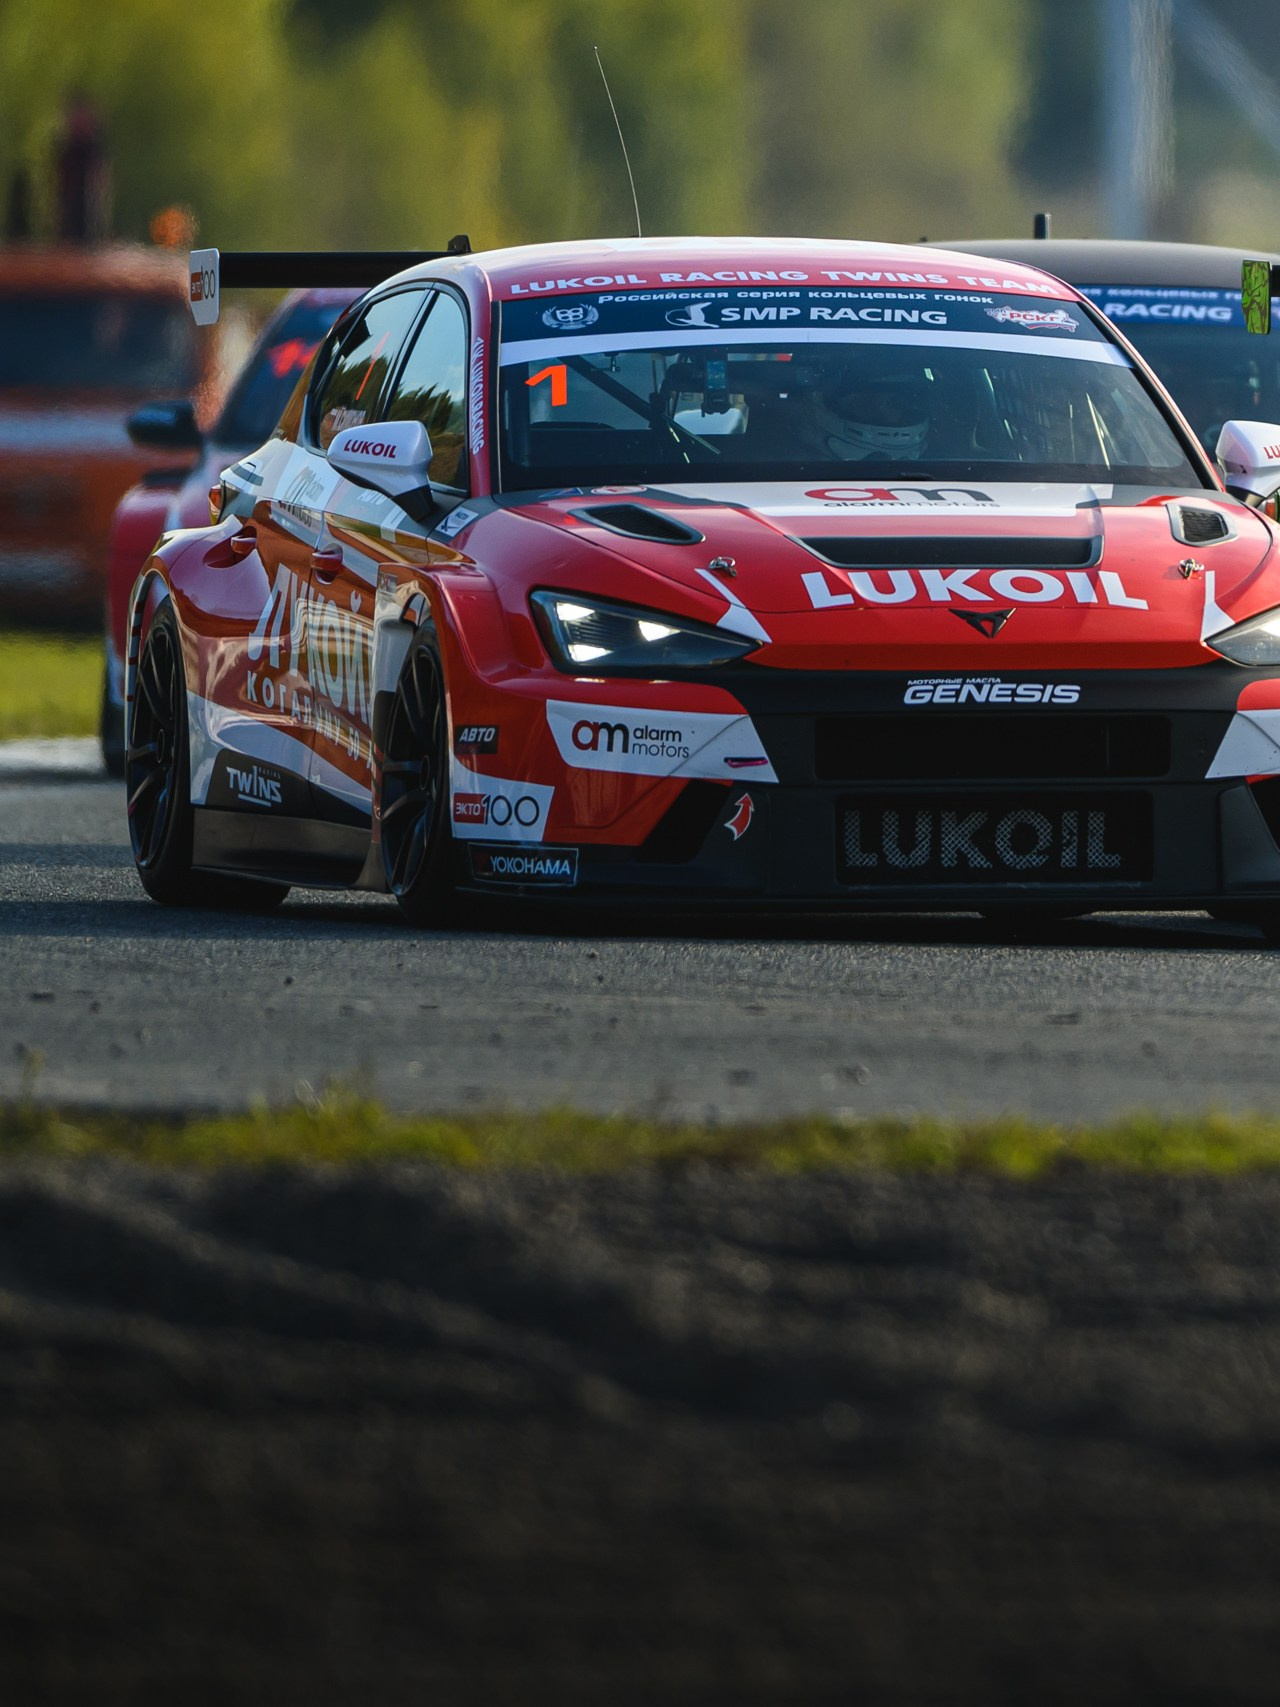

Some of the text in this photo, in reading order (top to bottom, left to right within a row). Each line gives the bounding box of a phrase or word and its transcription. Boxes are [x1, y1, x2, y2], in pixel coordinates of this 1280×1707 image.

[511, 274, 647, 295] LUKOIL
[659, 270, 808, 284] RACING
[820, 270, 948, 285] TWINS
[957, 275, 1060, 296] TEAM
[598, 290, 993, 304] Российская серия кольцевых гонок
[720, 306, 947, 325] SMP RACING
[1009, 312, 1060, 322] РСКГ
[1103, 302, 1233, 322] RACING
[524, 363, 567, 407] 1
[343, 439, 397, 459] LUKOIL
[801, 568, 1149, 611] LUKOIL
[247, 563, 375, 731] ЛУКОЙ
[907, 677, 1001, 686] МОТОРНЫЕ МАСЛА
[903, 683, 1081, 705] GENESIS
[459, 727, 496, 743] АВТО
[632, 724, 682, 743] alarm
[632, 740, 690, 759] motors
[226, 765, 282, 804] TWINS
[455, 794, 541, 827] ЭКТО 100
[844, 808, 1122, 870] LUKOIL
[490, 856, 571, 875] YOKOHAMA
